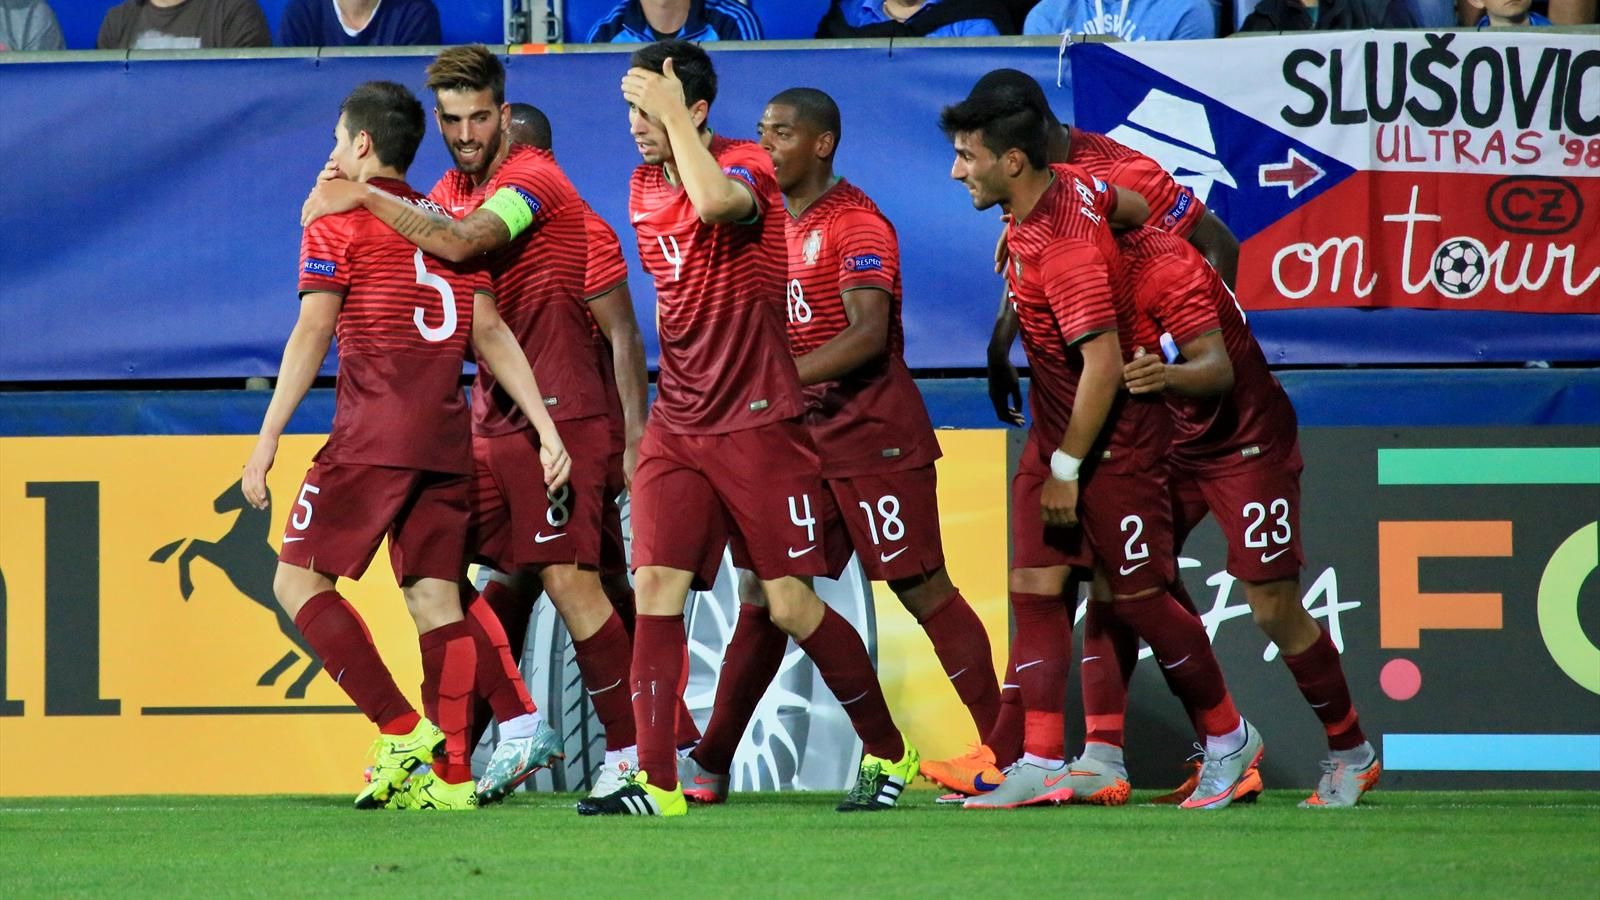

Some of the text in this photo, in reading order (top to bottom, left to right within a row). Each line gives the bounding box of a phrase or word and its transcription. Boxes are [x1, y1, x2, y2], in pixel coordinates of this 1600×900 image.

[1375, 124, 1600, 168] ULTRAS '98
[1172, 193, 1188, 219] RESPECT
[1501, 187, 1566, 223] CZ
[657, 235, 682, 281] 4
[1271, 185, 1600, 299] on tour
[305, 261, 336, 273] RESPECT
[413, 248, 457, 342] 5
[787, 278, 812, 323] 18
[292, 483, 320, 531] 5
[546, 485, 569, 527] 8
[788, 494, 816, 542] 4
[859, 495, 906, 545] 18
[1242, 498, 1292, 548] 23
[1120, 515, 1149, 560] 2
